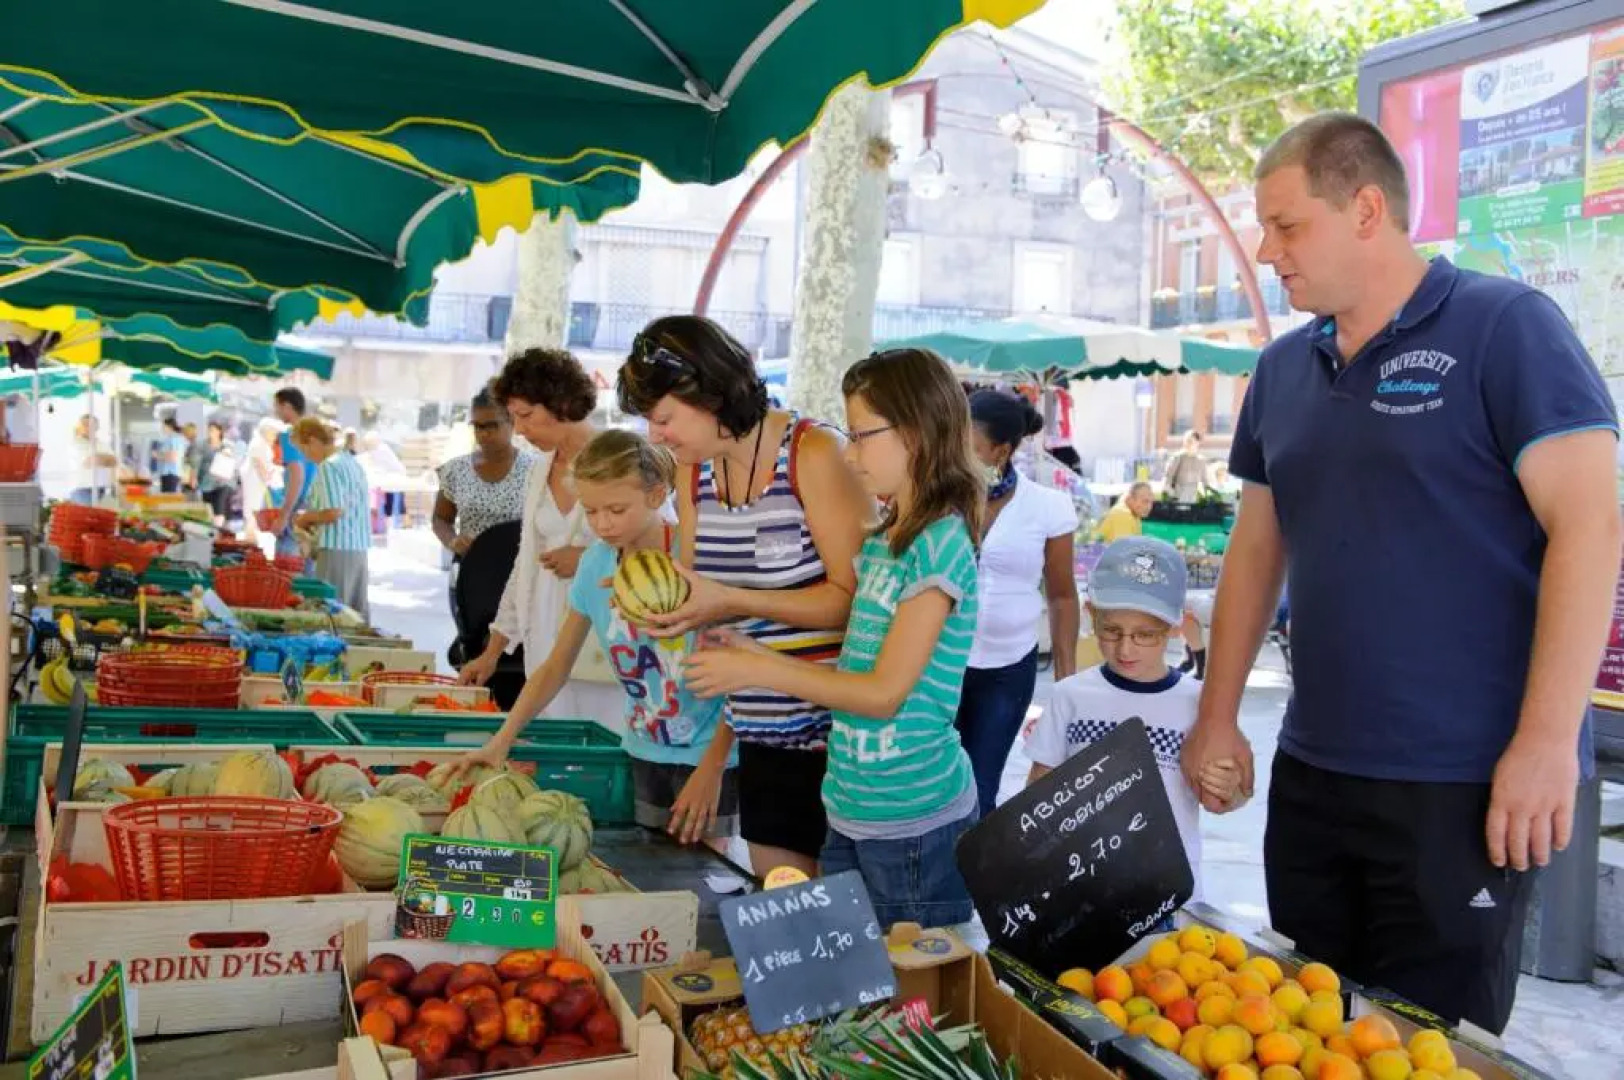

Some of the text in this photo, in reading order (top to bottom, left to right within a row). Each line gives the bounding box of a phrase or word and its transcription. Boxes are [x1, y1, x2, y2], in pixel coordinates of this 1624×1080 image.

[1380, 349, 1457, 380] UNIVERSITY
[1377, 379, 1440, 396] Challenge
[446, 858, 483, 871] PLATE
[1068, 834, 1123, 881] 2,70
[531, 911, 546, 926] €
[737, 885, 832, 927] ANANAS
[1126, 892, 1177, 939] FRANCE
[745, 957, 766, 983] 1
[811, 930, 854, 960] 1,70
[865, 922, 880, 940] €
